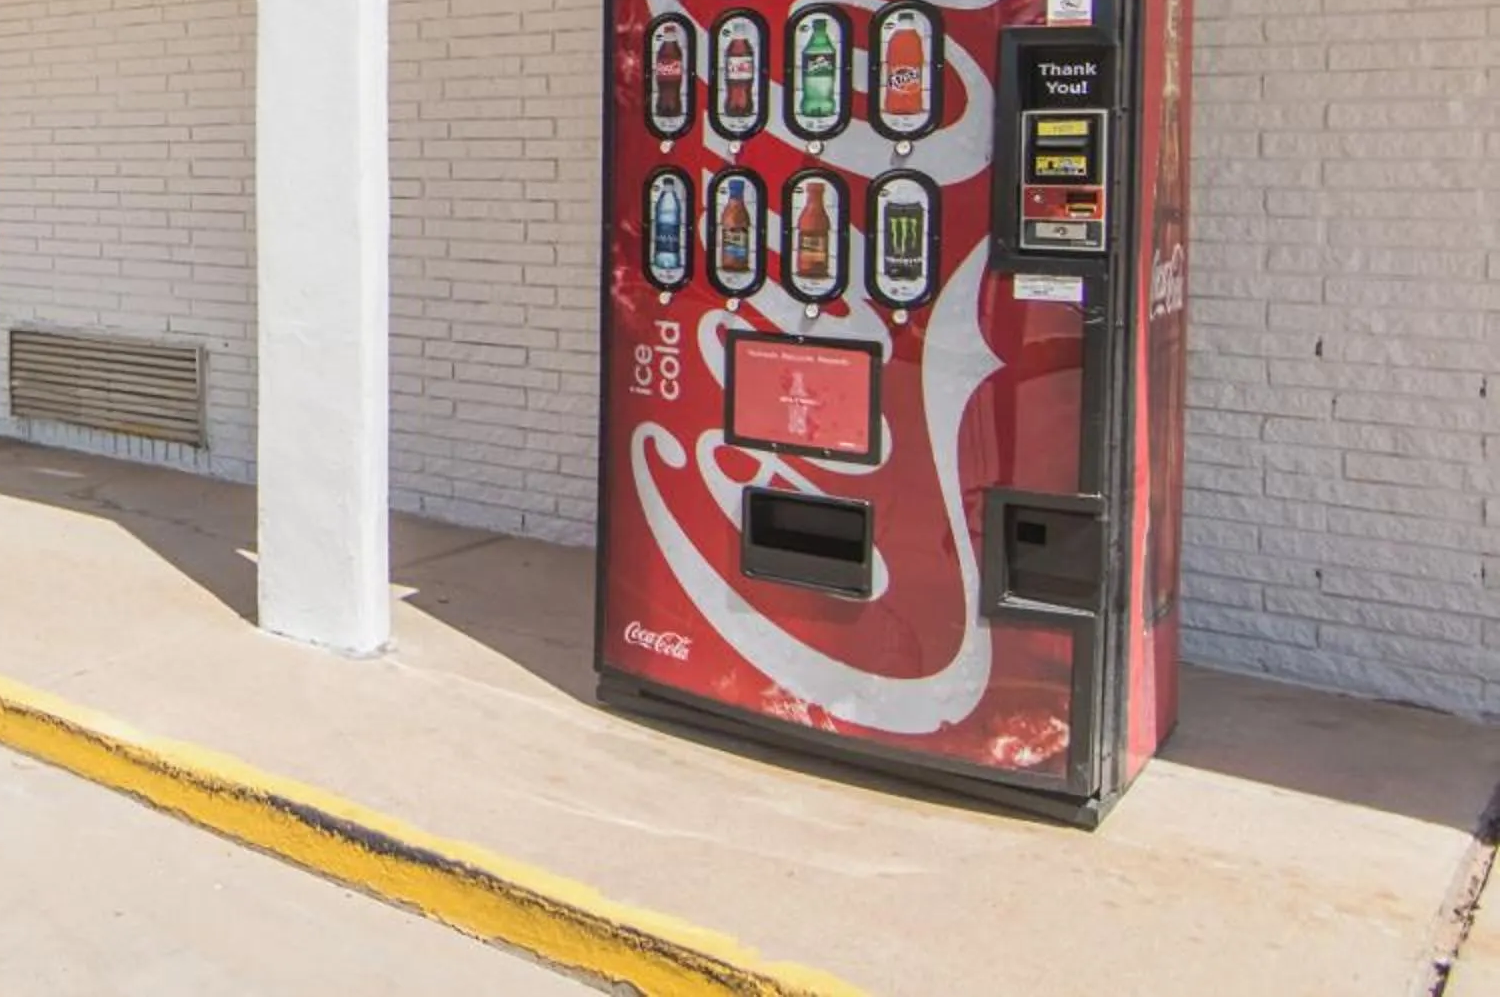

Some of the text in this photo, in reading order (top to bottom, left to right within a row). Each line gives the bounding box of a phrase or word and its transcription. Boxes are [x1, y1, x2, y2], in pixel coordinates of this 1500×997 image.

[1037, 62, 1097, 76] Thank
[1045, 80, 1088, 95] You!
[629, 343, 653, 395] ice
[653, 319, 680, 401] cold
